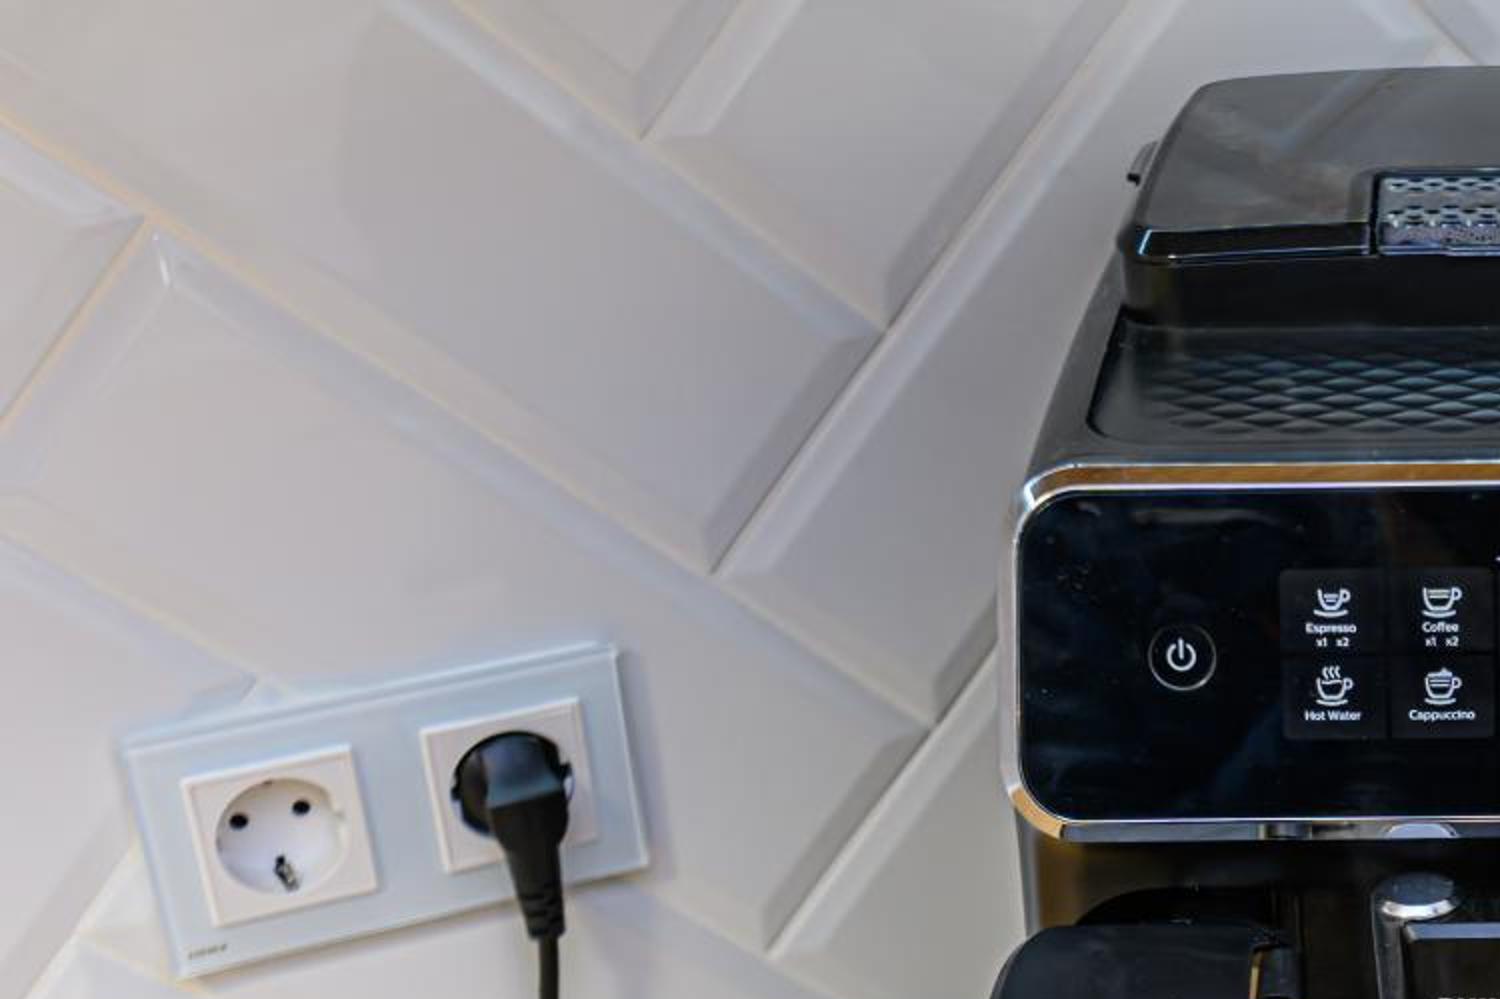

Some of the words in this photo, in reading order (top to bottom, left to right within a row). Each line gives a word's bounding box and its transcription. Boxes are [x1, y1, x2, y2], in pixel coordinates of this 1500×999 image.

[1305, 623, 1357, 634] Espresso
[1422, 621, 1459, 633] Coffee
[1316, 637, 1327, 647] x1
[1336, 637, 1349, 647] x2
[1425, 637, 1437, 647] x1
[1446, 637, 1459, 647] x2
[1305, 710, 1327, 721] Hot
[1328, 710, 1362, 721] Water
[1409, 710, 1476, 722] Cappuccino
